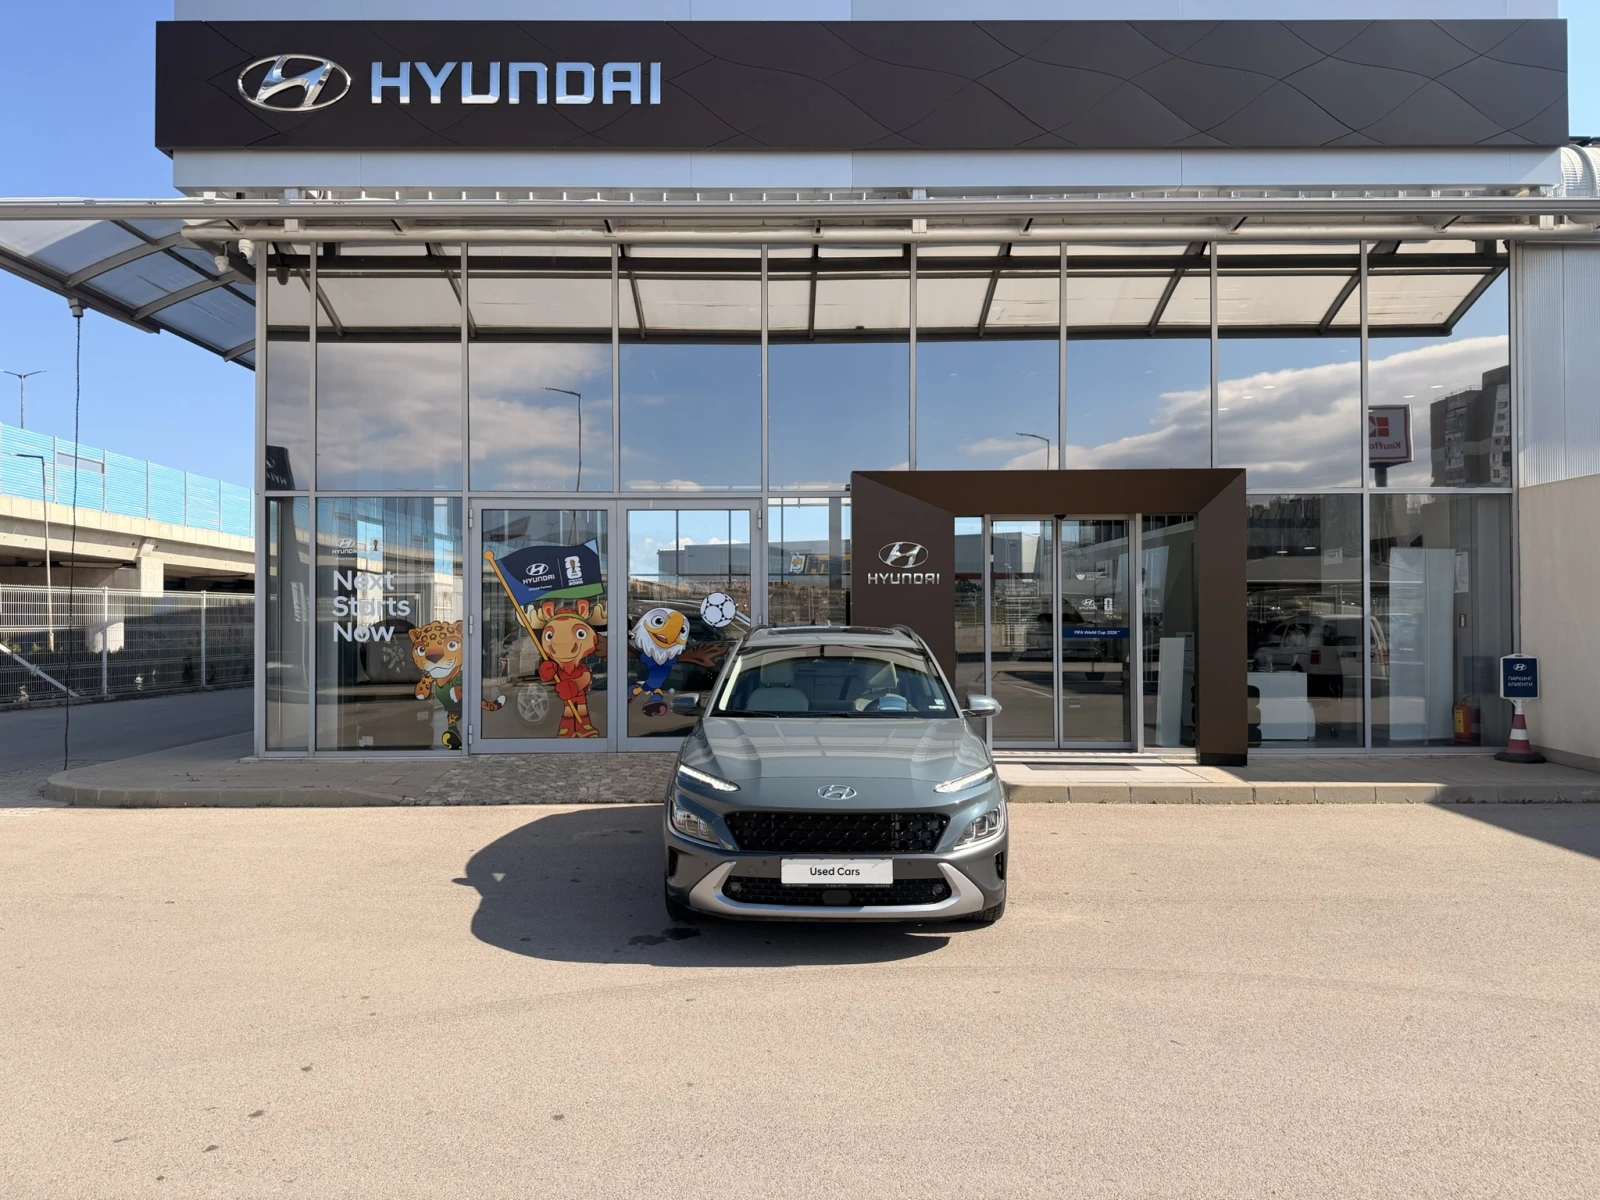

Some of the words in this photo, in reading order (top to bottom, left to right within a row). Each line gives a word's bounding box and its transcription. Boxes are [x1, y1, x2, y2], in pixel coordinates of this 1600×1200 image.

[371, 61, 661, 105] HYUNDAI
[333, 570, 395, 591] Next
[522, 574, 555, 585] HYUNDAI
[867, 572, 940, 585] HYUNDAI
[332, 595, 411, 617] Starts
[333, 622, 396, 643] Now
[809, 867, 835, 876] Used
[837, 867, 861, 876] Cars
